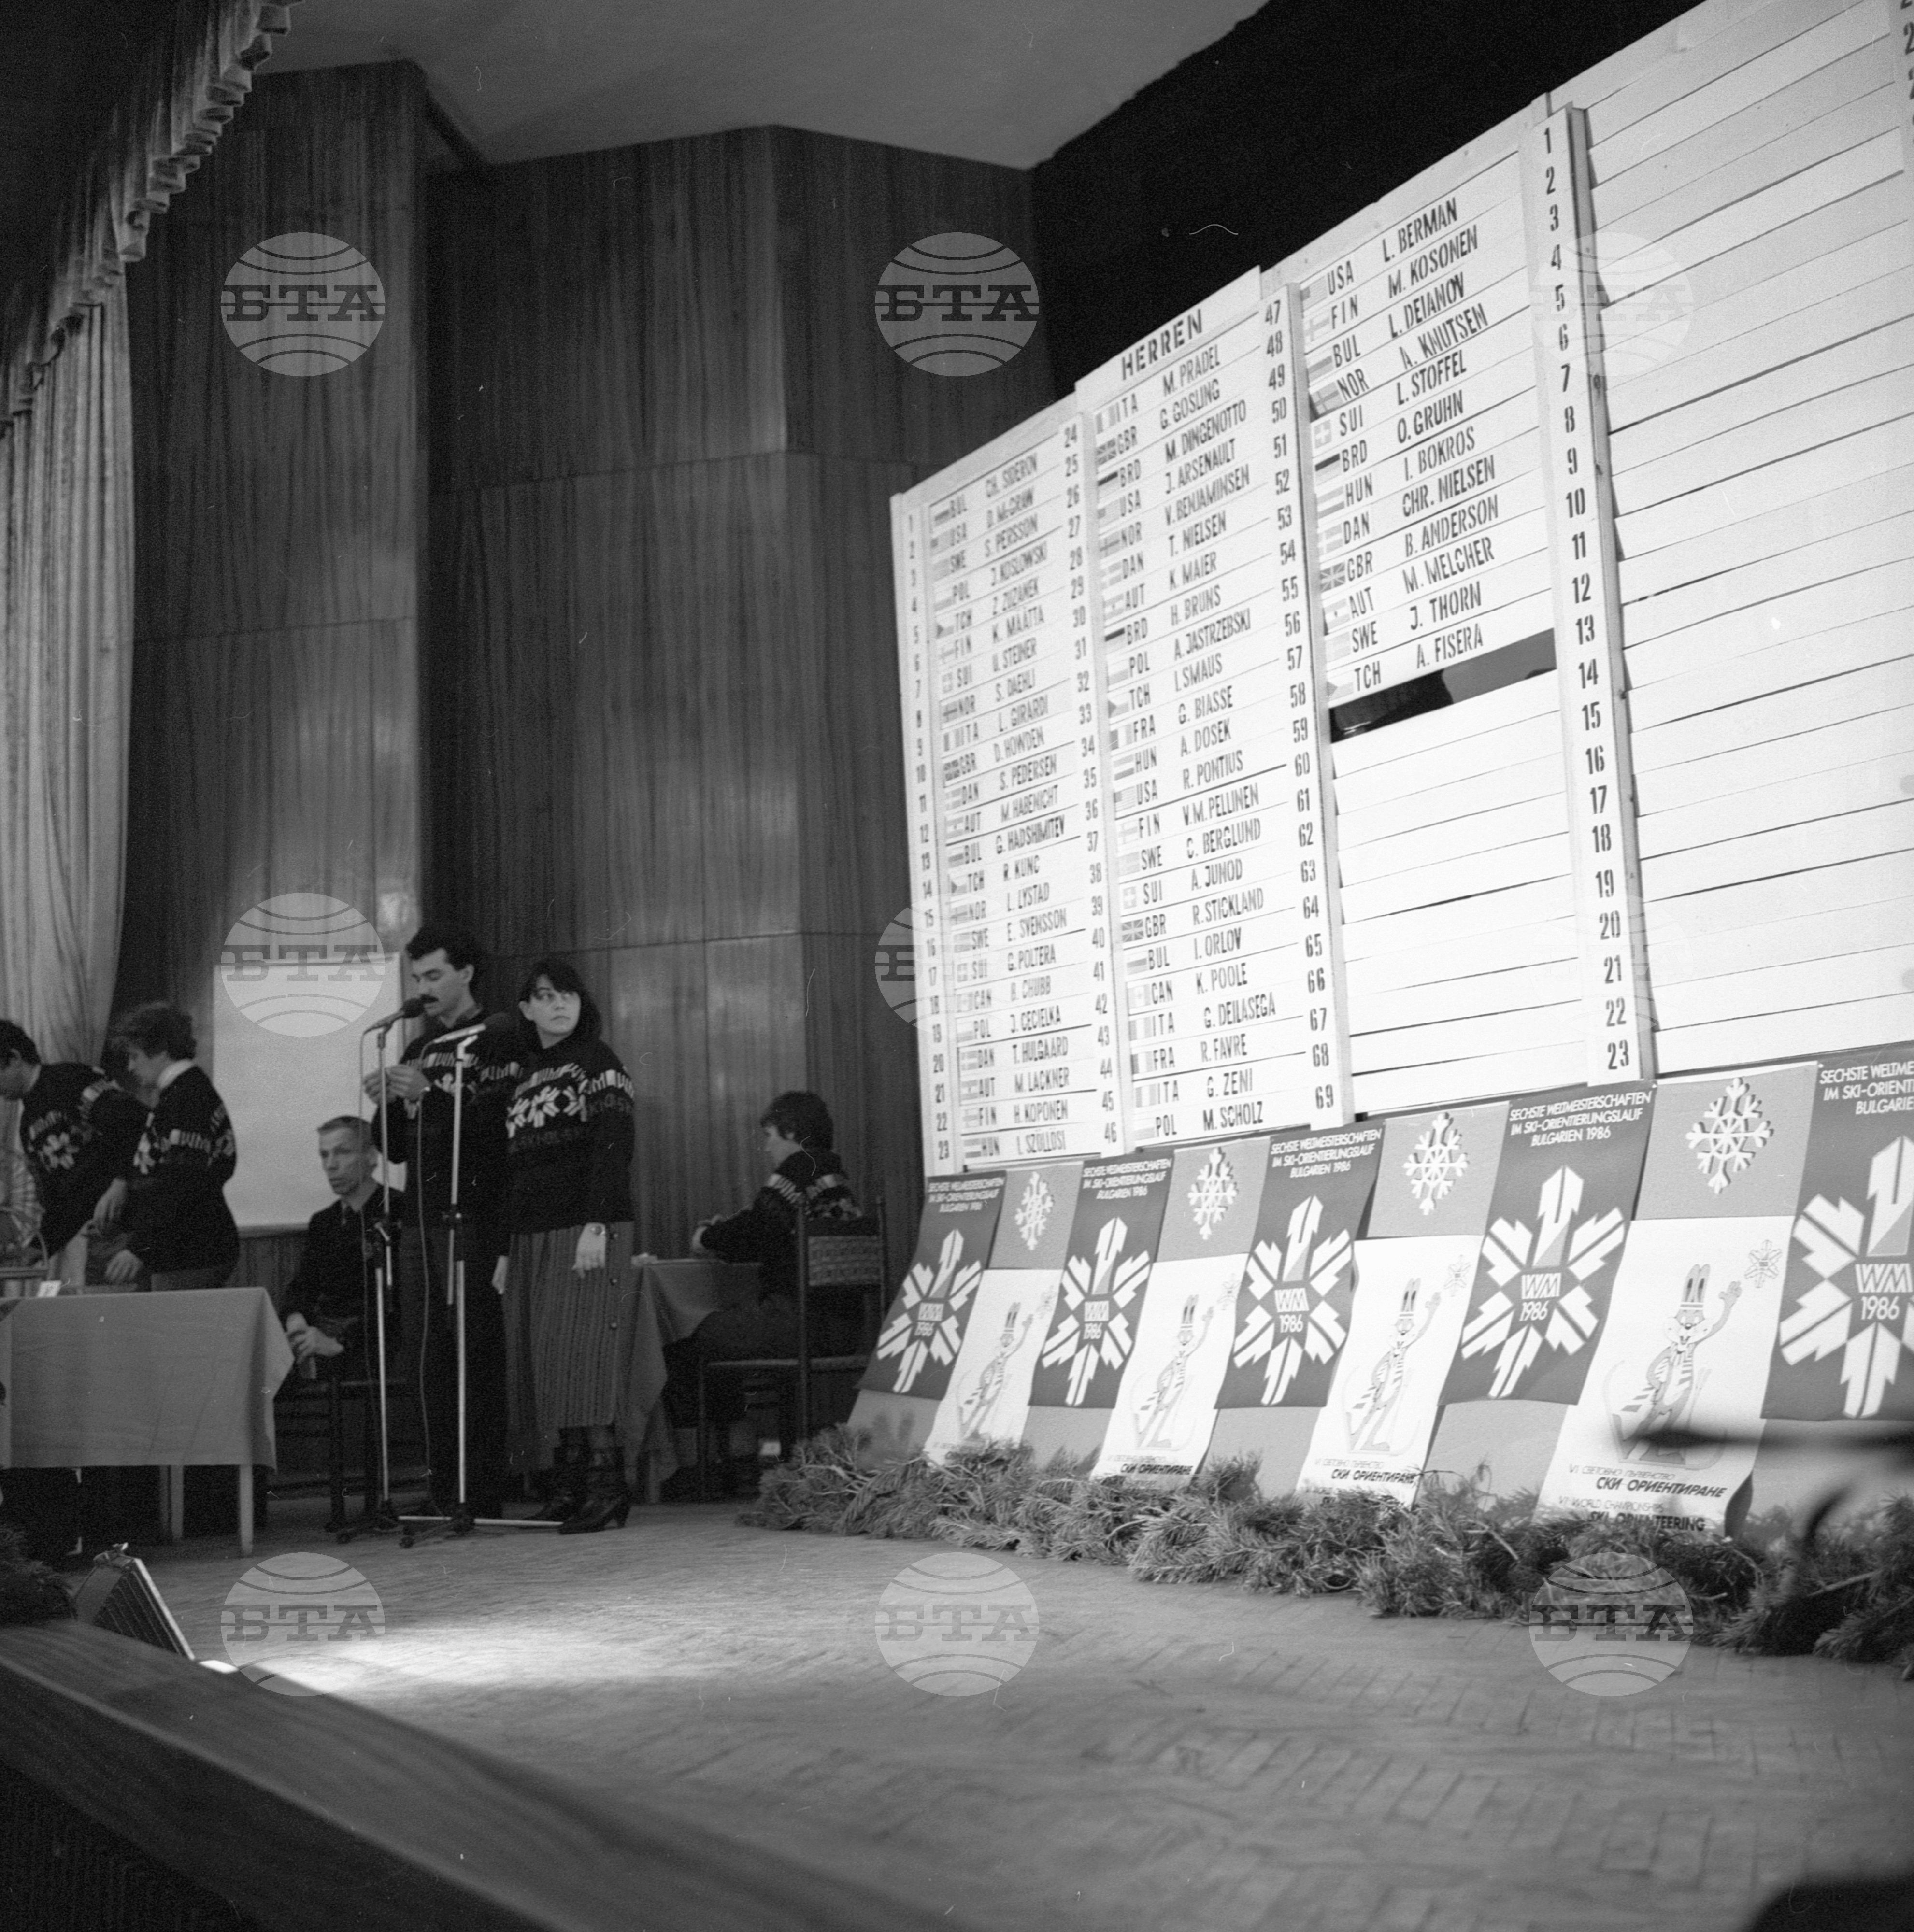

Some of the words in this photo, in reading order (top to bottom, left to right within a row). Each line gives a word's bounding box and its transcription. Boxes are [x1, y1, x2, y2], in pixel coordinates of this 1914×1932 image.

[1544, 127, 1551, 153] 1
[1546, 166, 1556, 195] 2
[1550, 204, 1559, 231] 3
[1328, 260, 1354, 295] USA
[1383, 239, 1395, 262] L.
[1398, 197, 1457, 253] BERMAN
[1551, 244, 1561, 270] 4
[1331, 294, 1358, 329] FIN
[1388, 269, 1405, 298] M.
[1410, 225, 1478, 285] KOSONEN
[1265, 299, 1281, 325] 47
[1555, 284, 1565, 312] 5
[1333, 335, 1361, 368] BUL
[1388, 314, 1402, 339] L.
[1403, 271, 1464, 329] DEIANOV
[1122, 308, 1202, 381] HERREN
[1266, 330, 1283, 357] 48
[1559, 323, 1568, 351] 6
[1337, 369, 1369, 401] NOR
[1400, 346, 1417, 369] A.
[1418, 303, 1488, 358] KNUTSEN
[1269, 364, 1285, 390] 49
[1561, 363, 1570, 392] 7
[1340, 405, 1363, 436] SUI
[1397, 383, 1409, 405] L.
[1412, 350, 1467, 398] STOFFEL
[1271, 397, 1286, 423] 50
[1564, 406, 1575, 433] 8
[1343, 440, 1368, 472] BRD
[1414, 390, 1464, 435] GRUHN
[1274, 434, 1287, 458] 51
[1345, 472, 1373, 507] HUN
[1418, 426, 1475, 473] BOKROS
[1567, 447, 1578, 474] 9
[1275, 469, 1290, 495] 52
[1343, 511, 1370, 545] DAN
[1402, 486, 1434, 516] CHR.
[1438, 455, 1495, 502] NIELSEN
[1566, 487, 1586, 518] 10
[1278, 505, 1292, 530] 53
[1122, 551, 1144, 579] DAN
[1183, 510, 1227, 551] NIELSEN
[1280, 539, 1296, 565] 54
[1347, 551, 1373, 582] GBR
[1405, 532, 1417, 557] B.
[1422, 495, 1498, 551] ANDERSON
[1572, 531, 1586, 560] 11
[1282, 576, 1298, 602] 55
[1349, 587, 1374, 618] AUT
[1402, 566, 1424, 593] M.
[1425, 536, 1495, 584] MELCHER
[1572, 573, 1592, 604] 12
[1127, 617, 1148, 645] BRD
[1185, 584, 1221, 620] BRUNS
[1285, 611, 1300, 636] 56
[1352, 621, 1378, 652] SWE
[1410, 606, 1423, 630] J.
[1430, 581, 1482, 623] THORN
[1575, 614, 1595, 645] 13
[1287, 645, 1302, 670] 57
[1355, 661, 1381, 691] TCH
[1416, 644, 1430, 668] A.
[1435, 623, 1483, 662] FISERA
[1578, 658, 1599, 689] 14
[1290, 682, 1306, 708] 58
[1133, 714, 1156, 742] FRA
[1195, 685, 1233, 719] BIASSE
[1582, 701, 1601, 731] 15
[1293, 717, 1308, 743] 59
[1135, 746, 1157, 773] HUN
[1195, 718, 1231, 753] DOSEK
[1295, 752, 1310, 777] 60
[1585, 746, 1605, 774] 16
[1136, 779, 1158, 805] USA
[1197, 750, 1243, 786] PONTIUS
[1297, 788, 1310, 812] 61
[1590, 785, 1607, 814] 17
[1142, 845, 1163, 870] SWE
[1203, 818, 1261, 854] BERGLUND
[1298, 822, 1313, 847] 62
[1592, 824, 1612, 853] 18
[1143, 880, 1163, 904] SUI
[1205, 858, 1243, 887] JUNOD
[1300, 859, 1316, 883] 63
[1596, 869, 1614, 898] 19
[1145, 914, 1167, 938] GBR
[1205, 887, 1264, 923] STICKLAND
[1303, 895, 1319, 919] 64
[1599, 910, 1621, 940] 20
[1148, 946, 1170, 970] BUL
[1205, 927, 1242, 957] ORLOV
[1305, 933, 1322, 957] 65
[1308, 967, 1326, 994] 66
[1603, 954, 1622, 984] 21
[1151, 980, 1173, 1004] CAN
[1211, 963, 1248, 992] POOLE
[1153, 1012, 1175, 1036] ITA
[1310, 1007, 1327, 1031] 67
[1605, 997, 1627, 1027] 22
[1153, 1047, 1175, 1071] FRA
[1214, 1033, 1247, 1061] FAVRE
[1312, 1043, 1329, 1067] 68
[1607, 1039, 1629, 1070] 23
[1157, 1080, 1179, 1104] ITA
[1224, 1068, 1253, 1095] ZENI
[1819, 1066, 1868, 1084] SECHSTE
[1315, 1084, 1334, 1109] 69
[1823, 1087, 1839, 1101] IM
[1156, 1114, 1177, 1136] POL
[1220, 1101, 1263, 1129] SCHOLZ
[1509, 1106, 1546, 1121] SECHSTE
[1511, 1123, 1522, 1135] IM
[1531, 1128, 1583, 1147] BULGARIEN
[1586, 1126, 1611, 1140] 1986
[1519, 1300, 1549, 1321] 1986
[1860, 1295, 1900, 1320] 1986
[1280, 1314, 1303, 1333] 1986
[1596, 1477, 1622, 1490] СКИ
[1627, 1478, 1727, 1497] ОРИЕНТИРАНЕ
